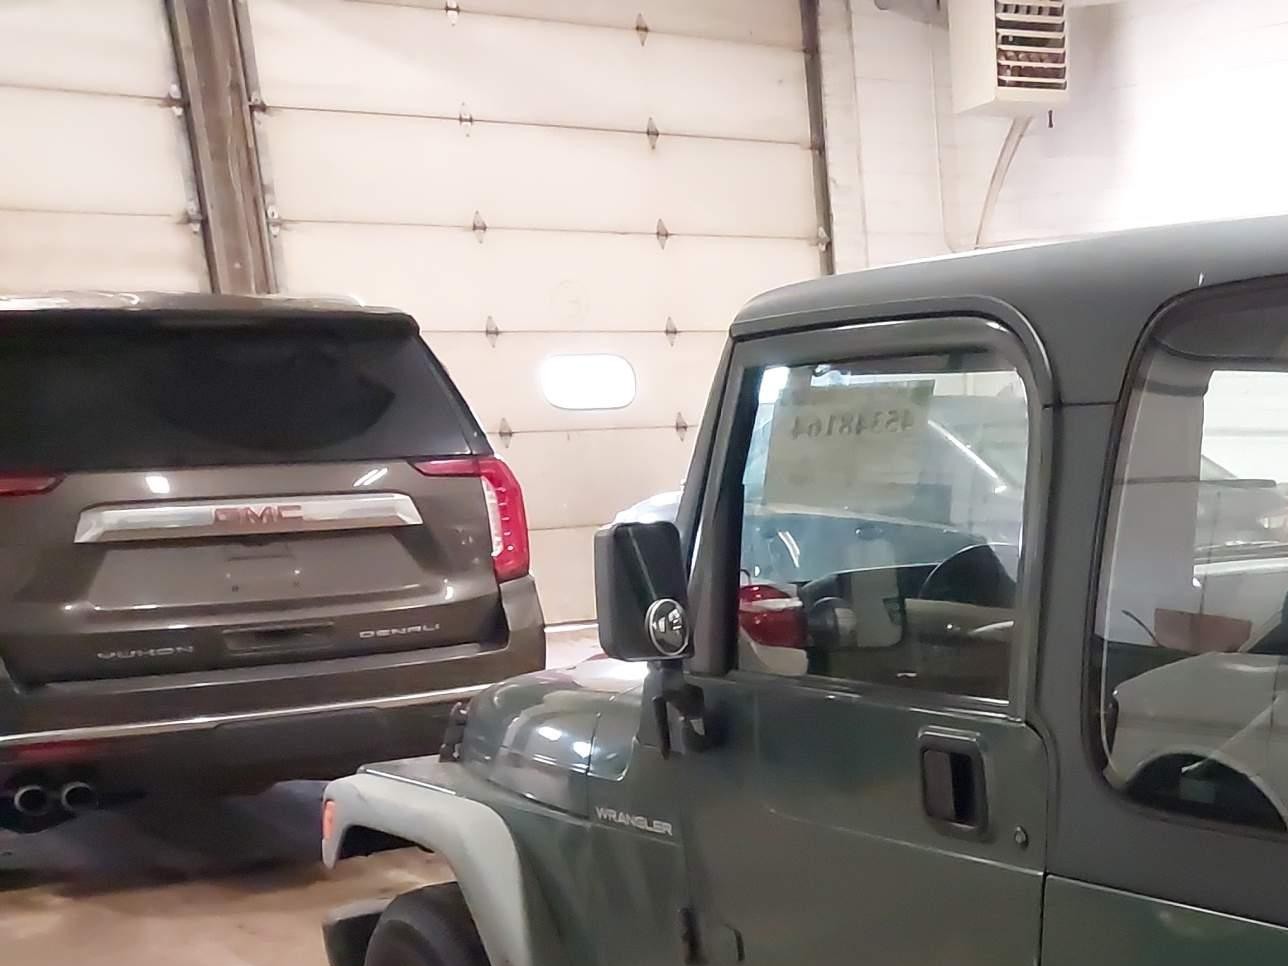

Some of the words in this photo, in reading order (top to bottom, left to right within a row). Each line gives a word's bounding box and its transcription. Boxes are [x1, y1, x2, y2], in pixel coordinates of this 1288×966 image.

[213, 505, 304, 524] GMC
[359, 622, 441, 640] DENALI
[97, 644, 195, 660] YUKON
[595, 806, 674, 837] WRANGLER
